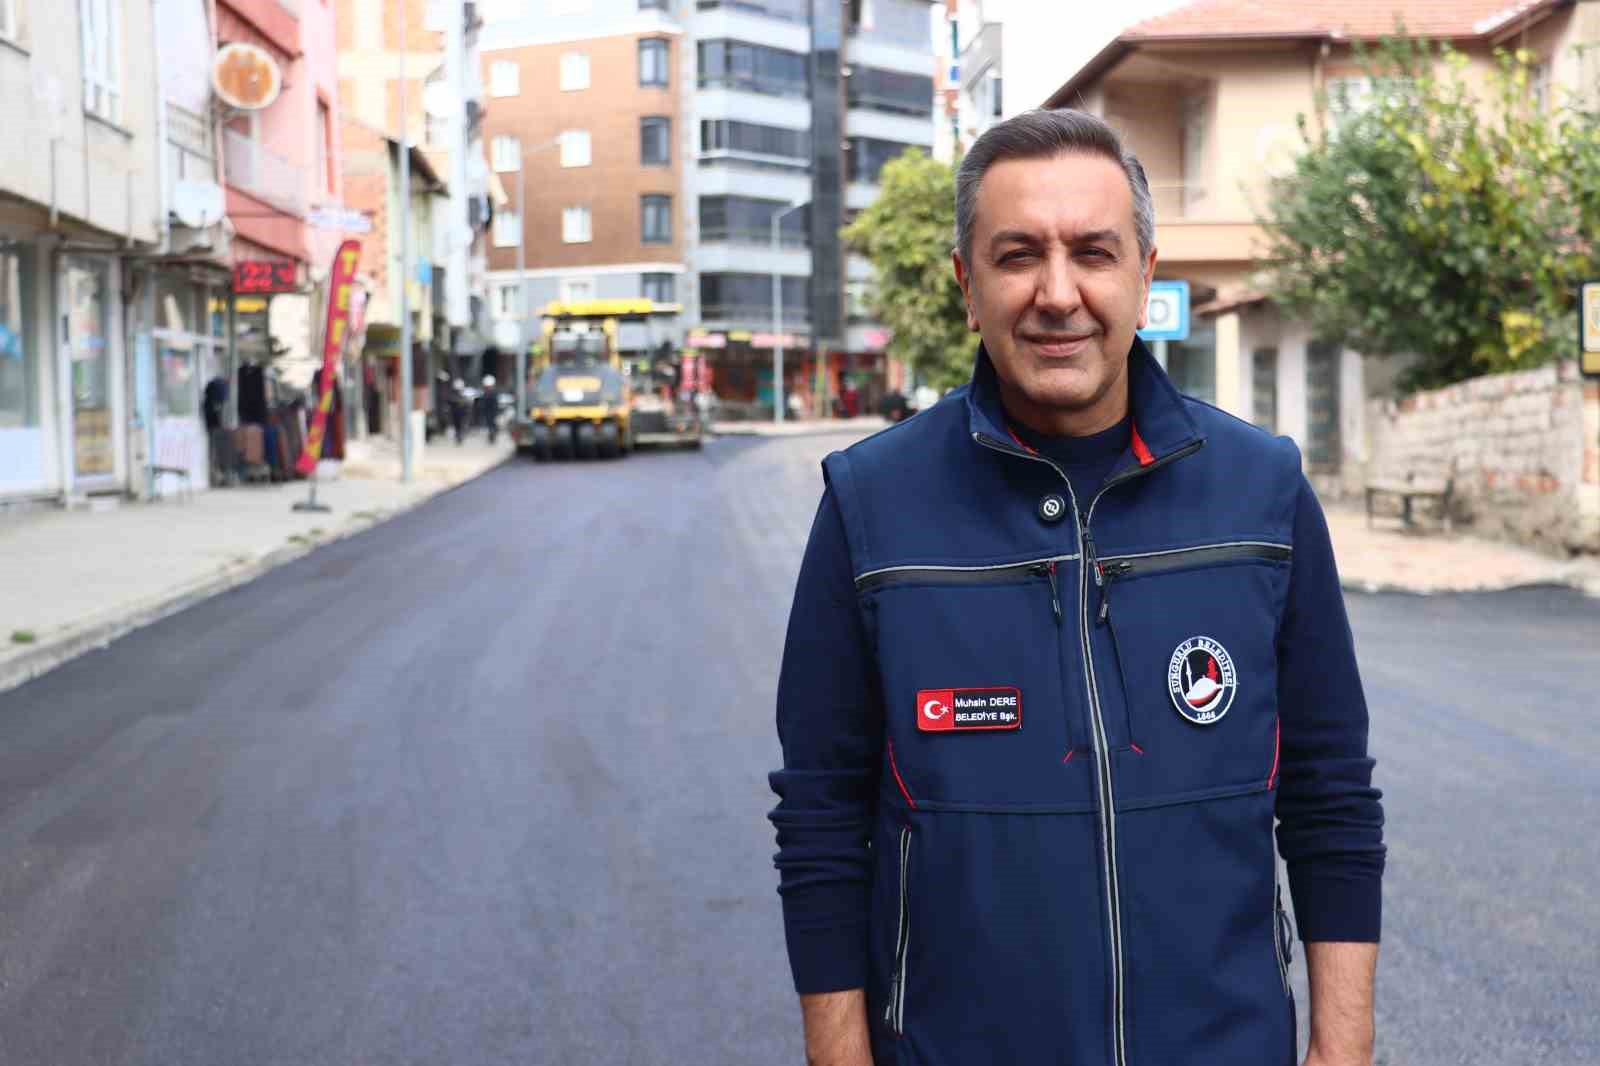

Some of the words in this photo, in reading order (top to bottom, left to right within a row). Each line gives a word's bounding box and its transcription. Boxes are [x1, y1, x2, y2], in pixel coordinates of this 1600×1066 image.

[955, 697, 987, 708] Muhsin
[989, 696, 1017, 706] DERE
[955, 711, 998, 721] BELEDİYE
